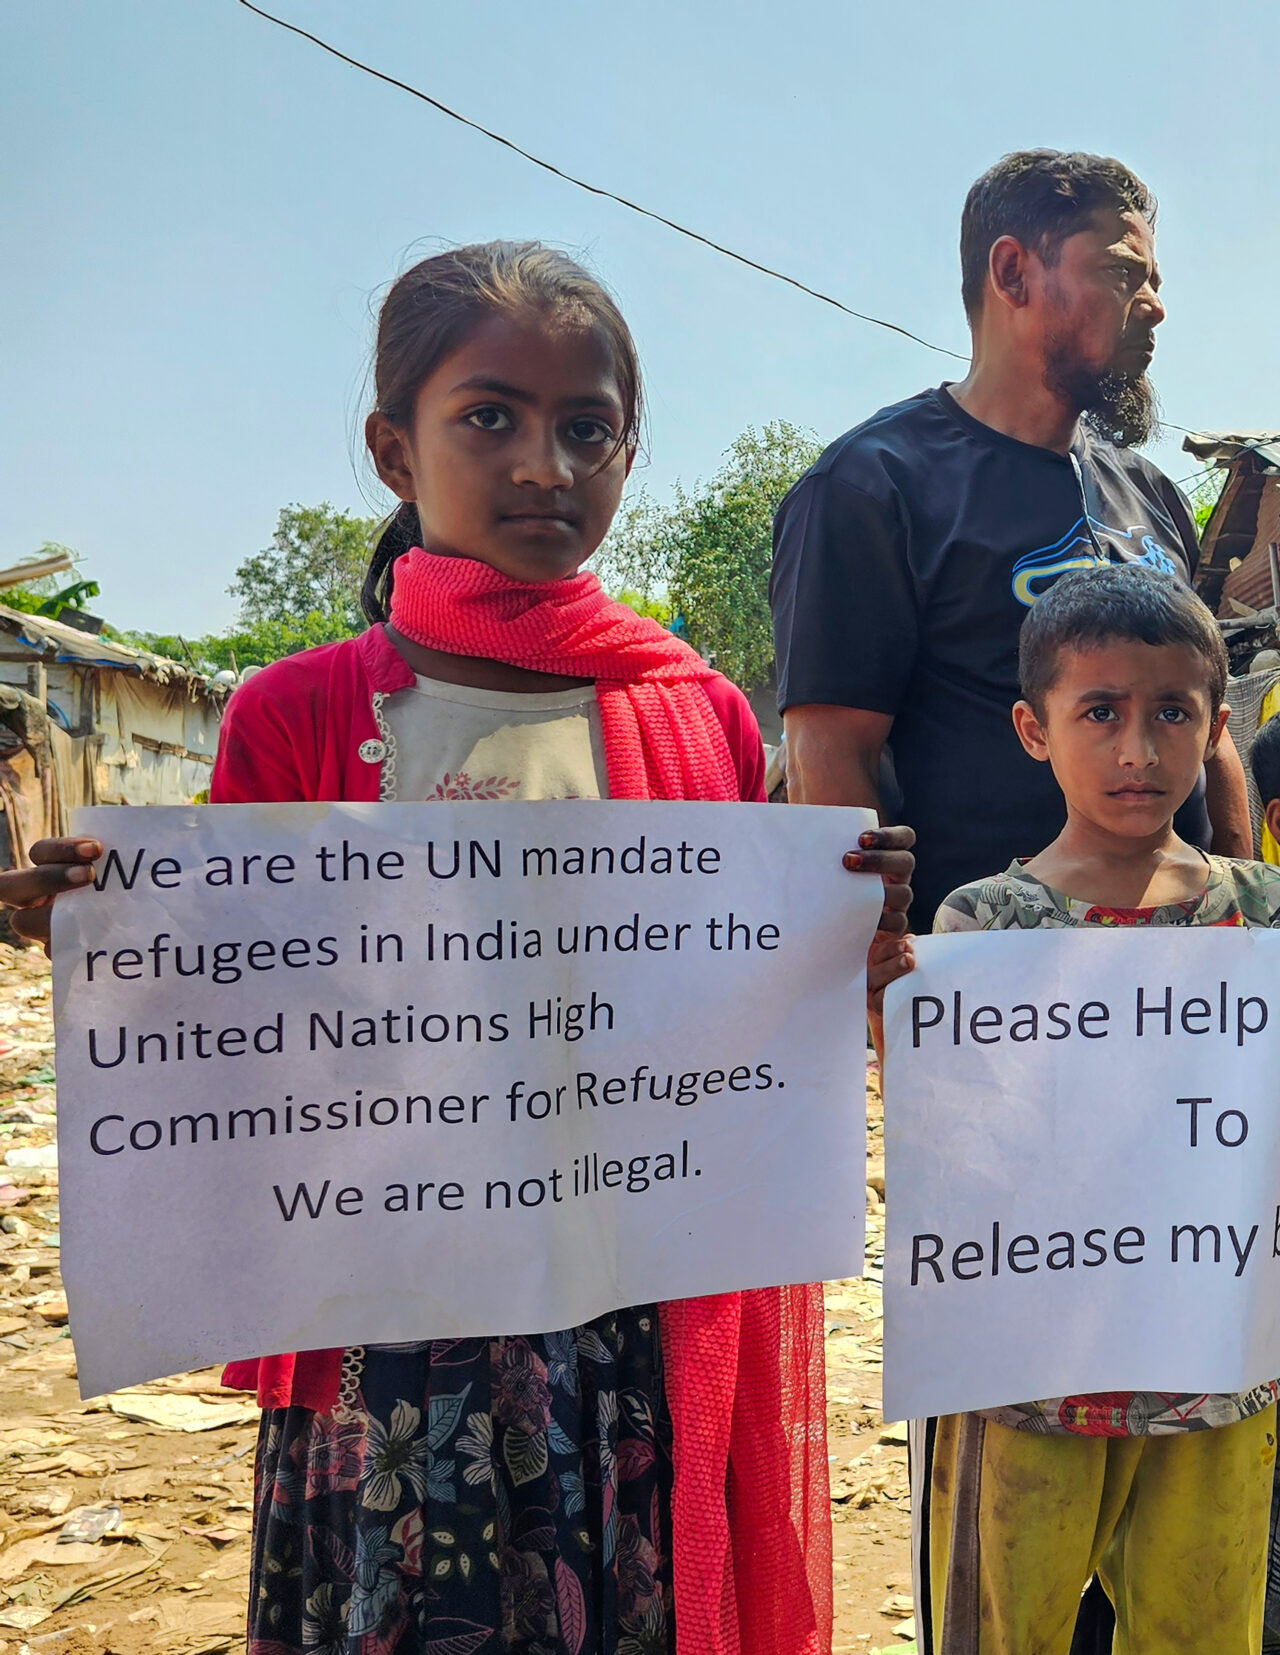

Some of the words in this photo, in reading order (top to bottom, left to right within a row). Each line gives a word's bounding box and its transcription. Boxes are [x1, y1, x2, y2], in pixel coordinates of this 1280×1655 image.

[92, 845, 181, 891] We
[206, 855, 295, 886] are
[315, 840, 404, 882] the
[428, 840, 501, 879] UN
[523, 836, 720, 876] mandate
[87, 933, 338, 984] refugees
[361, 925, 403, 963] in
[428, 920, 541, 961] India
[558, 913, 691, 954] under
[706, 913, 780, 950] the
[89, 1013, 283, 1068] United
[310, 1005, 509, 1051] Nations
[530, 992, 613, 1041] High
[912, 991, 1109, 1048] Please
[1136, 981, 1268, 1046] Help
[90, 1090, 489, 1155] Commissioner
[506, 1081, 566, 1121] for
[577, 1064, 784, 1110] Refugees.
[1176, 1098, 1248, 1147] To
[273, 1180, 363, 1221] We
[384, 1183, 464, 1212] are
[486, 1169, 563, 1209] not
[574, 1140, 701, 1196] illegal.
[911, 1221, 1145, 1286] Release
[1171, 1225, 1259, 1277] my
